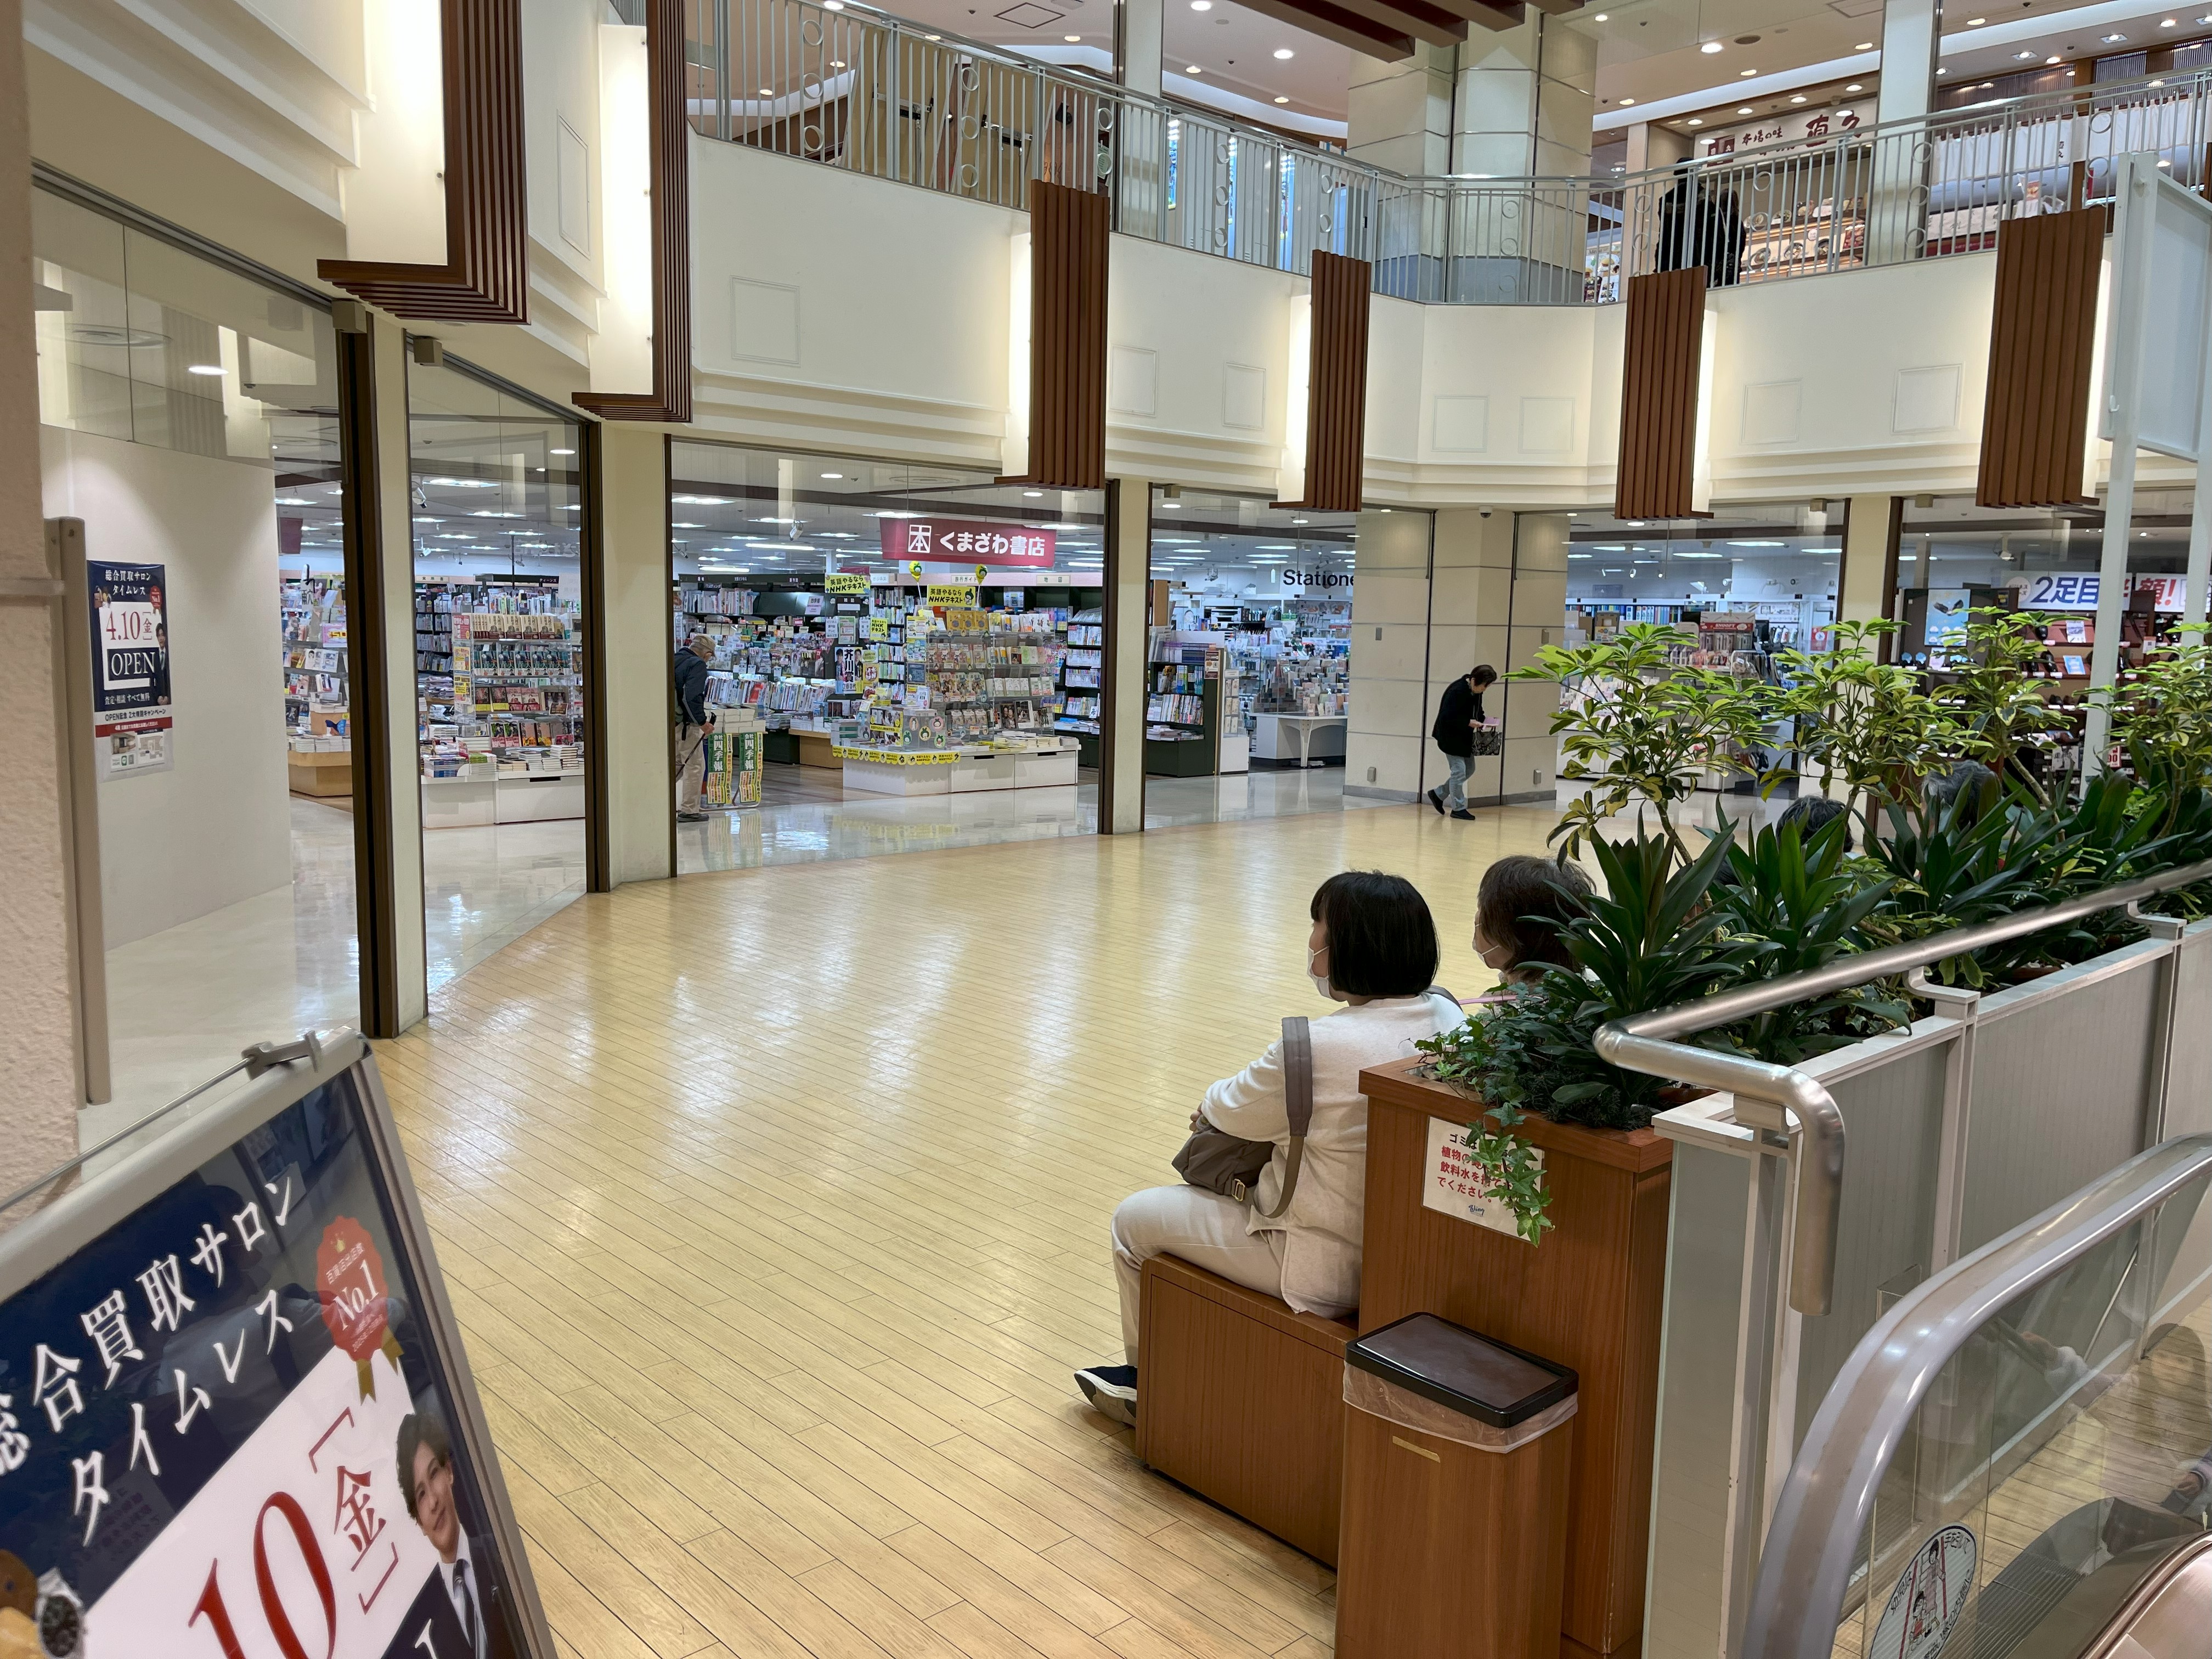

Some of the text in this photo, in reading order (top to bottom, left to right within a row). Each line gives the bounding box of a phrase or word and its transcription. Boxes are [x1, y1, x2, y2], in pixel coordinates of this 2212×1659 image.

[940, 531, 1045, 556] くまざわ書店
[105, 569, 151, 582] 総合買取サロン
[830, 576, 864, 586] 英語やるなら
[112, 584, 146, 596] タイムレス
[830, 582, 866, 593] NHKテキスト
[930, 588, 962, 596] 英語やるなら
[105, 611, 141, 641] 4.10
[111, 652, 156, 677] OPEN
[844, 648, 854, 682] 芥川賞
[1468, 1204, 1485, 1216] Wing
[333, 1259, 379, 1331] No.1
[71, 1289, 295, 1546] タイムレス
